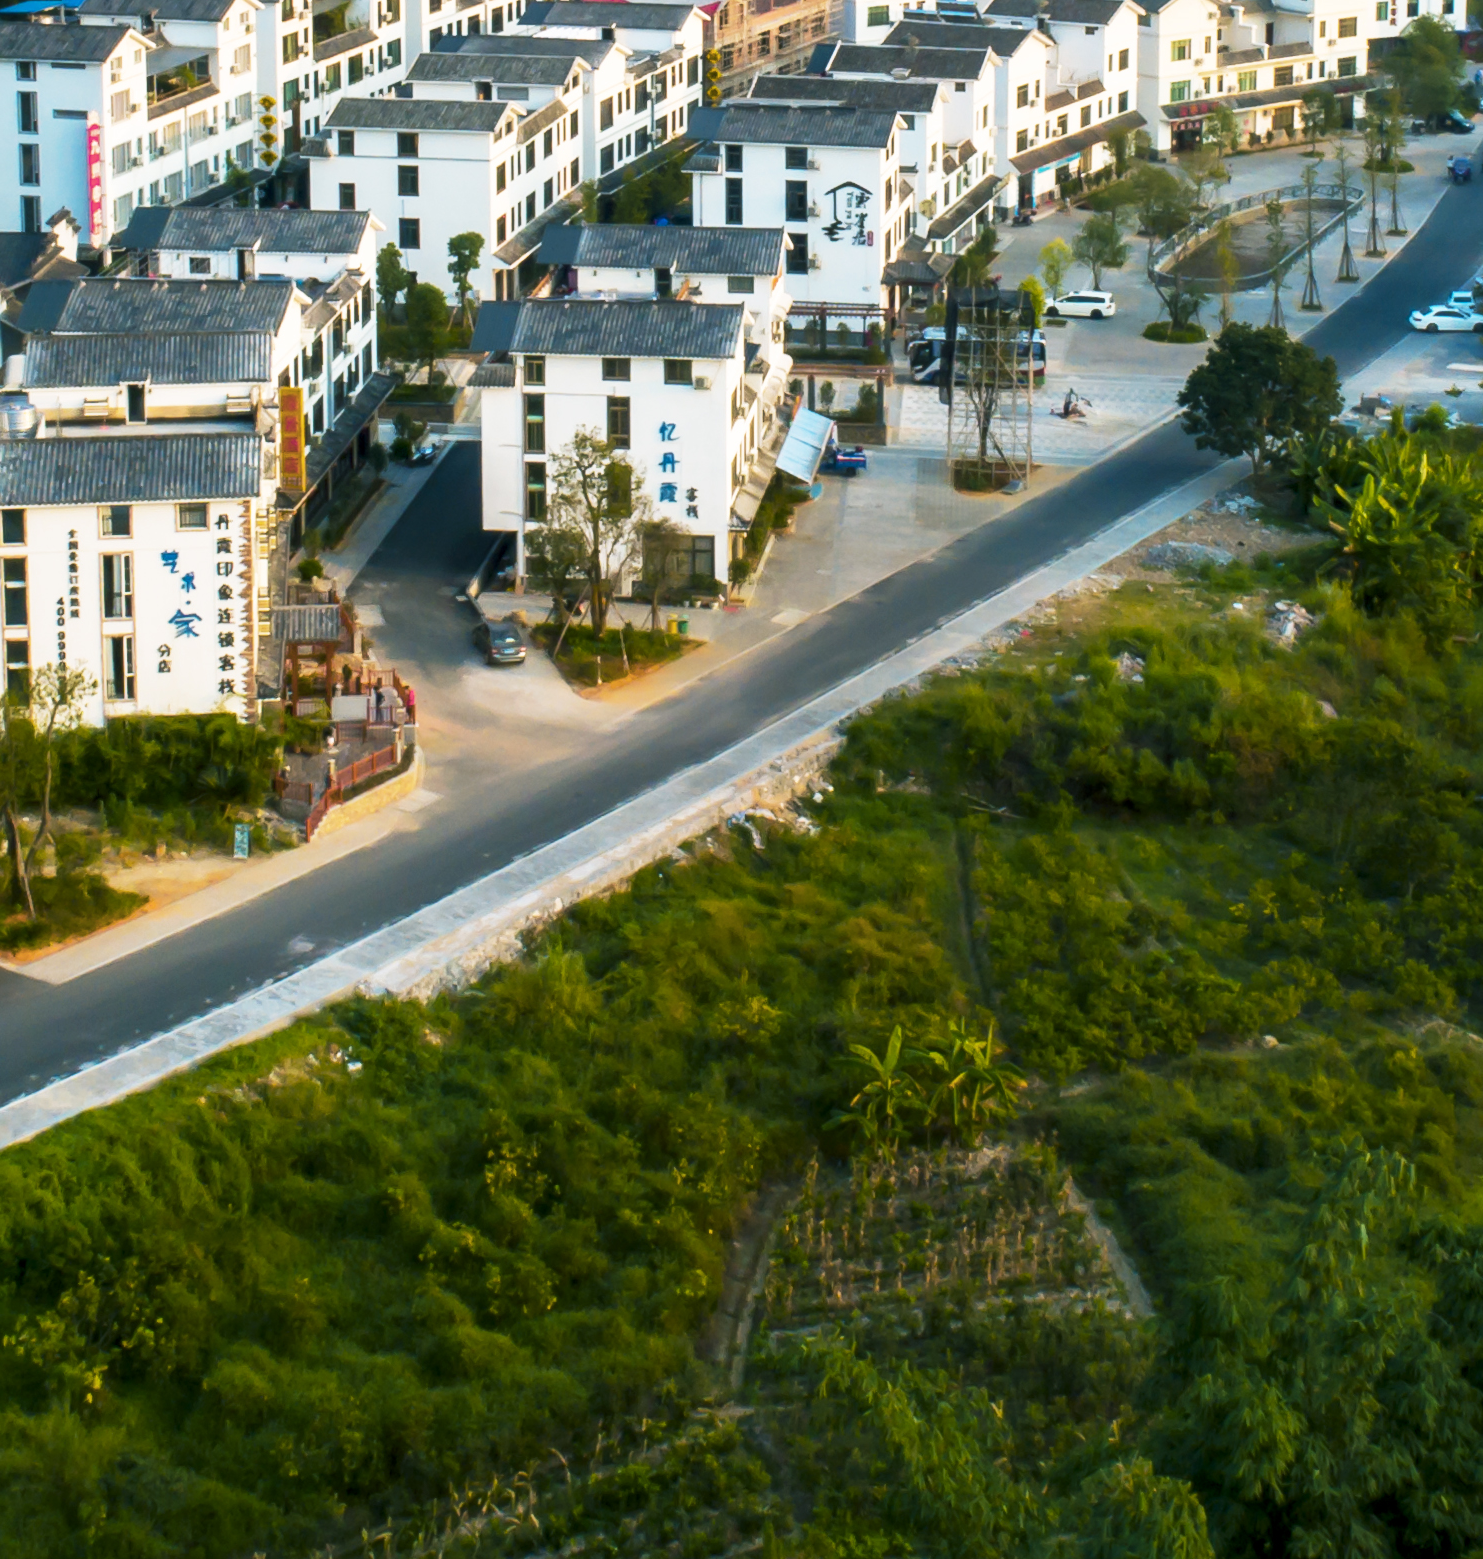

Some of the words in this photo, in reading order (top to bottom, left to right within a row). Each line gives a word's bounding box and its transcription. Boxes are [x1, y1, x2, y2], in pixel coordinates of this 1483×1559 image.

[658, 421, 680, 503] 忆丹霞
[56, 596, 65, 626] 400
[215, 514, 235, 694] 丹霞印象连锁客栈
[157, 643, 172, 674] 分店
